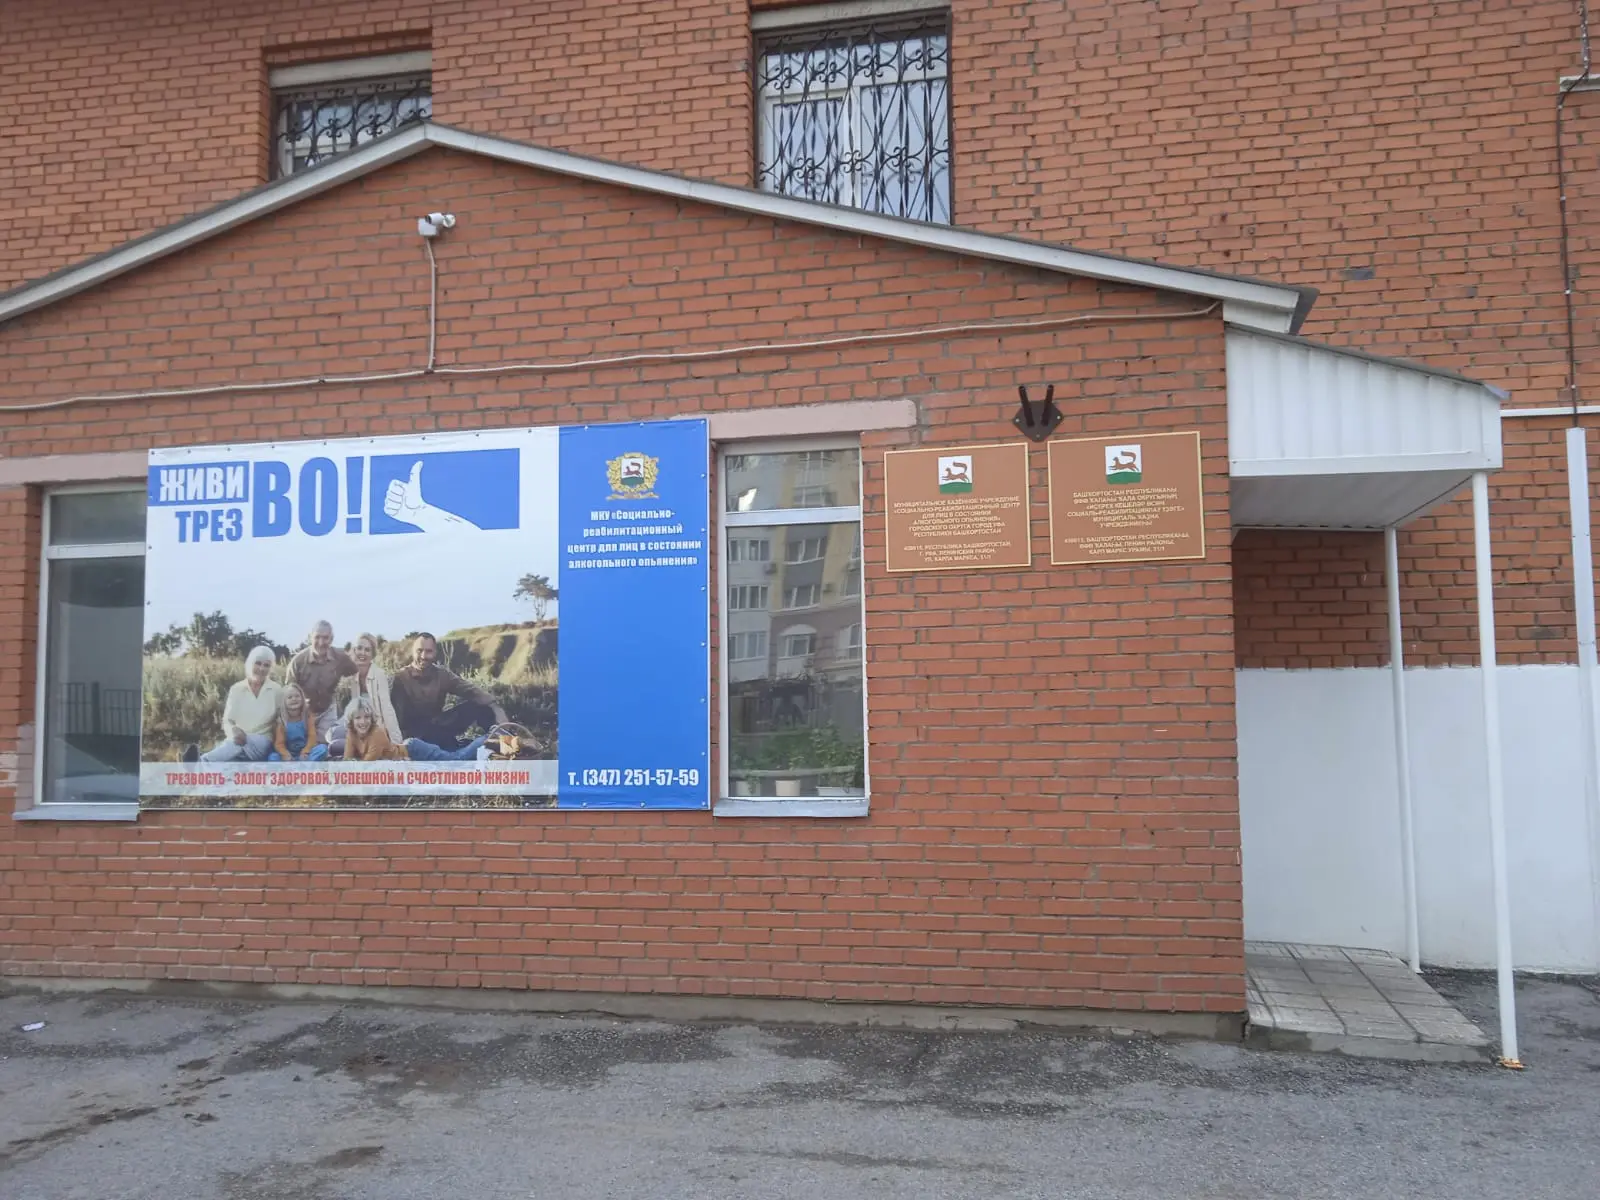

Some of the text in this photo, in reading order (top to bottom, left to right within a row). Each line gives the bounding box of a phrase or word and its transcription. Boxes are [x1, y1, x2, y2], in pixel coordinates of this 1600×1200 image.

[160, 465, 244, 502] ЖИВИ
[252, 456, 364, 537] ВО!
[590, 509, 676, 521] МКУ «Социально-
[175, 508, 243, 543] ТРЕЗ
[583, 523, 683, 538] реабилитационный
[567, 540, 701, 554] центр для лиц в состоянии
[568, 556, 698, 569] алкогольного опьянения»
[166, 772, 225, 786] ТРЕЗВОСТЬ
[233, 772, 268, 786] ЗАЛОГ
[270, 771, 332, 787] ЗДОРОВОЙ,
[333, 770, 394, 785] УСПЕШНОЙ
[397, 772, 405, 784] И
[406, 769, 482, 785] СЧАСТЛИВОЙ
[484, 771, 530, 785] ЖИЗНИ!
[568, 768, 699, 786] т. (347) 251-57-59
